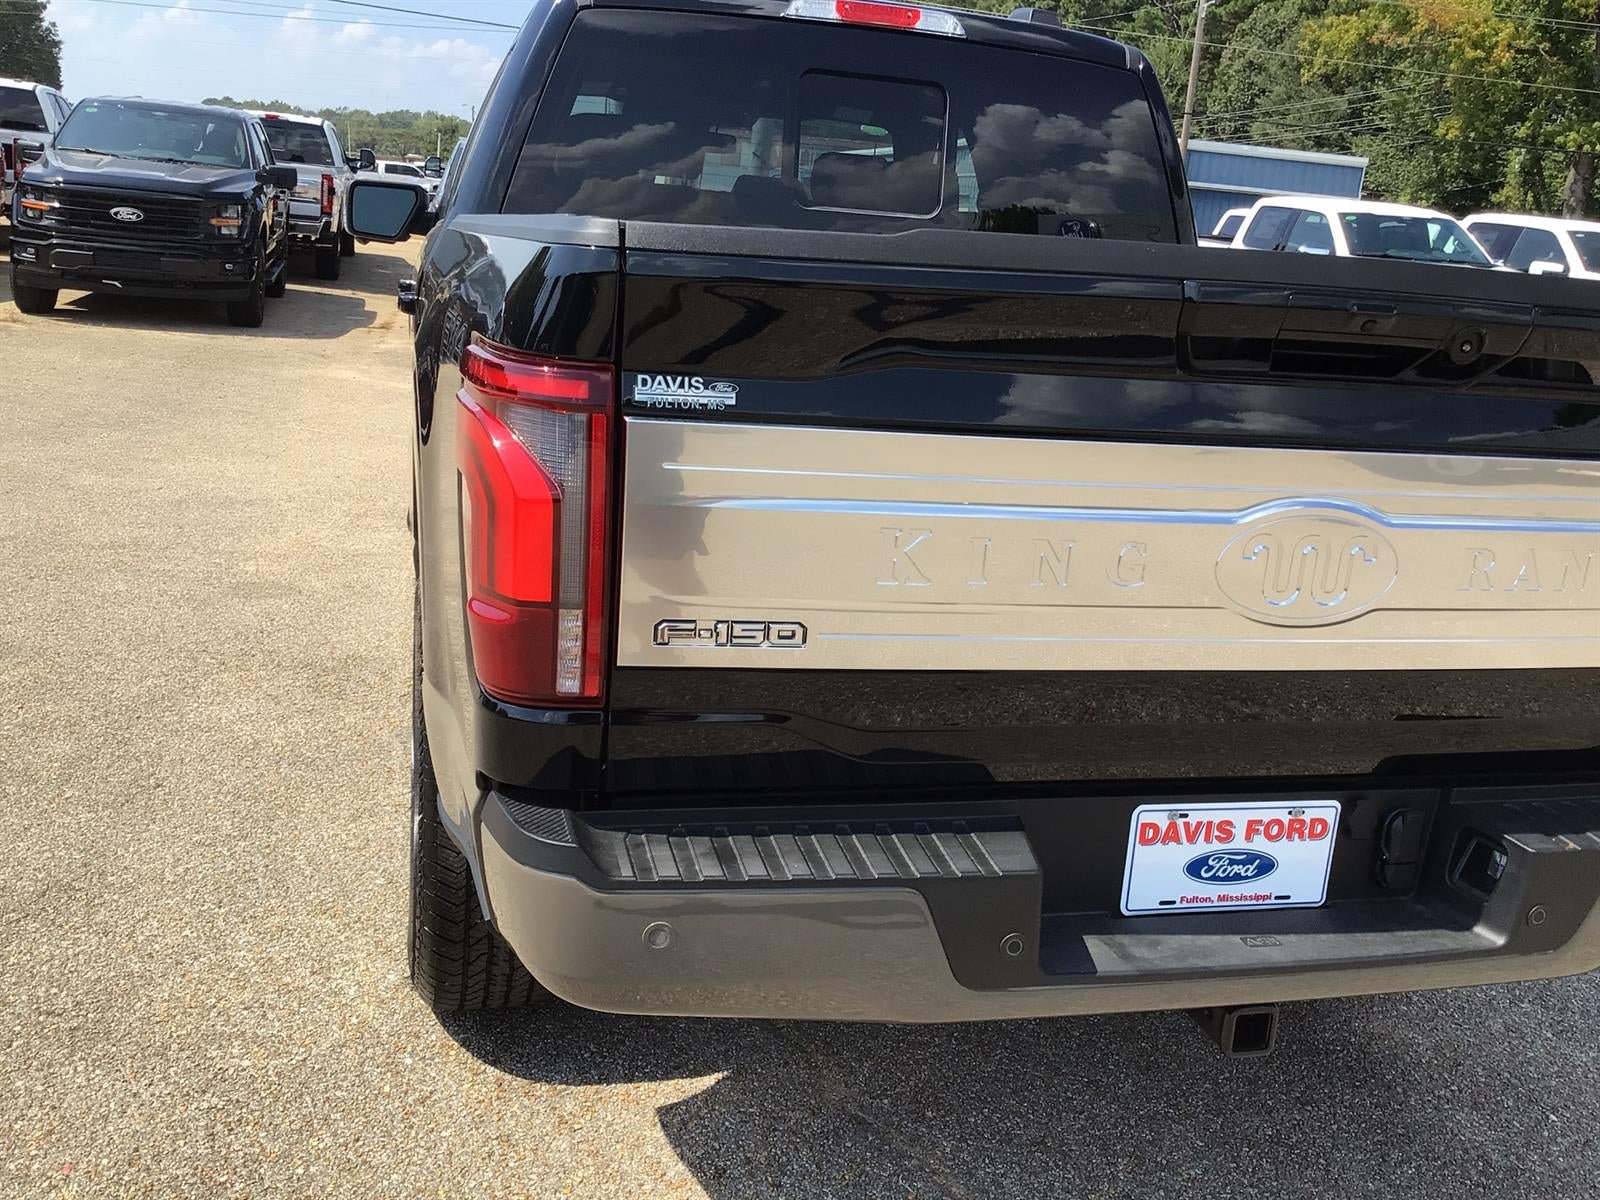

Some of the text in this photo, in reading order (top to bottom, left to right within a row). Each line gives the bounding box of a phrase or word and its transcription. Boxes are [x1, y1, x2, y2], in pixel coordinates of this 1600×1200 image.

[637, 374, 704, 393] DAVIS
[707, 399, 726, 411] MS
[876, 527, 1147, 587] KING
[652, 618, 808, 649] F-150
[1138, 817, 1330, 846] DAVIS FORD
[1201, 853, 1260, 878] Ford
[1179, 892, 1273, 905] Fulton, Mississippi
